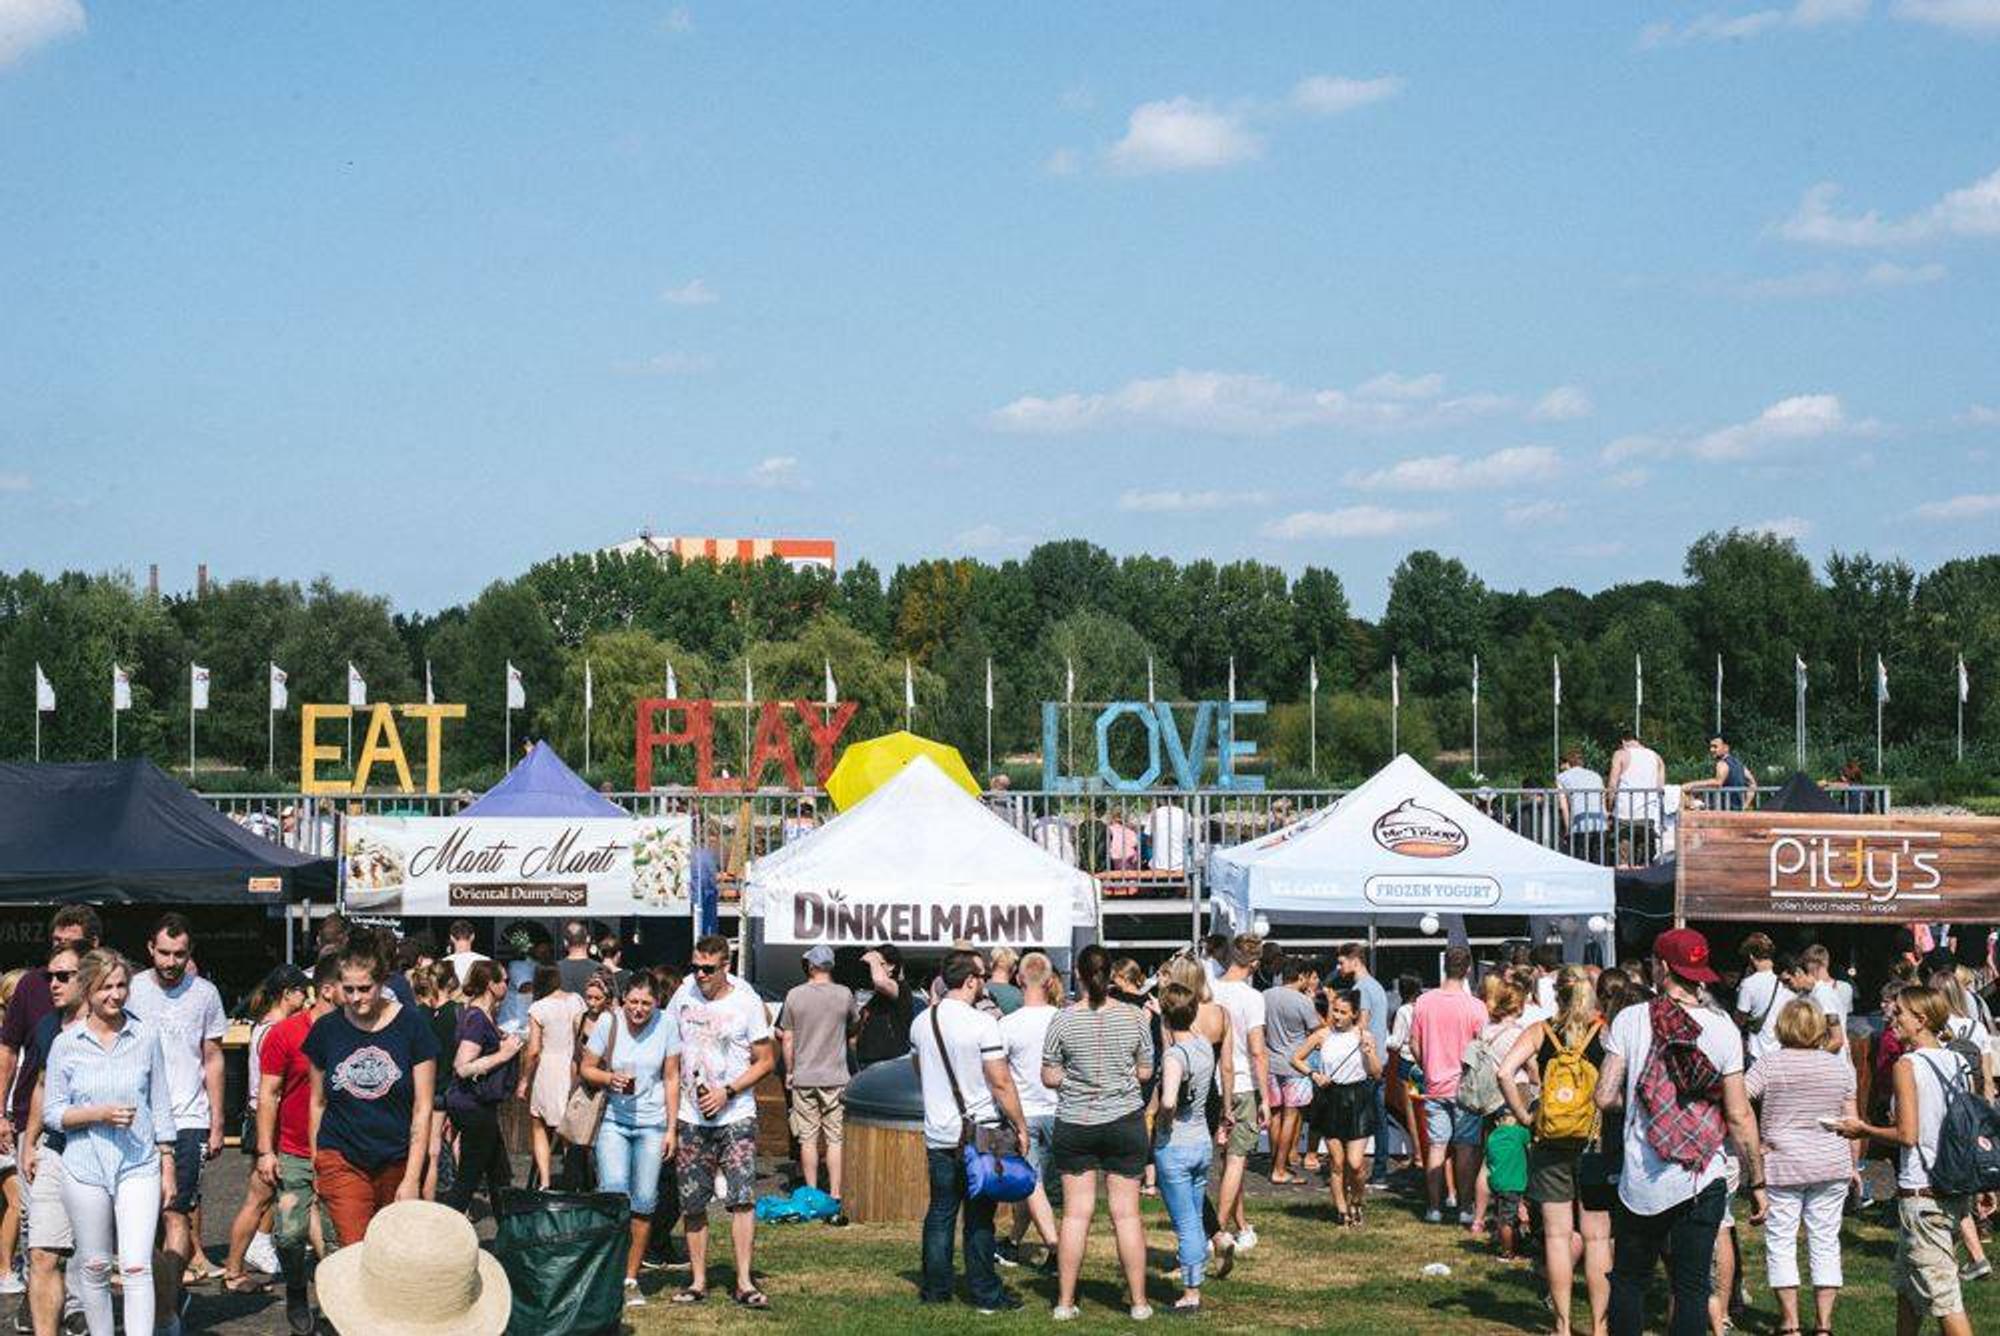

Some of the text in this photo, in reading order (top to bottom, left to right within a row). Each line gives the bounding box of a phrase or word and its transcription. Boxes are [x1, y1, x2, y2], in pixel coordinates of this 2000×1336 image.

[302, 703, 466, 795] EAT
[636, 699, 859, 792] PLAY
[1042, 701, 1267, 792] LOVE
[408, 825, 628, 879] Manti Manti
[1770, 837, 1941, 901] Pitty's
[451, 886, 584, 904] Oriental Dumplings
[793, 890, 1044, 942] DINKELMANN
[1375, 883, 1492, 899] FROZEN YOGURT
